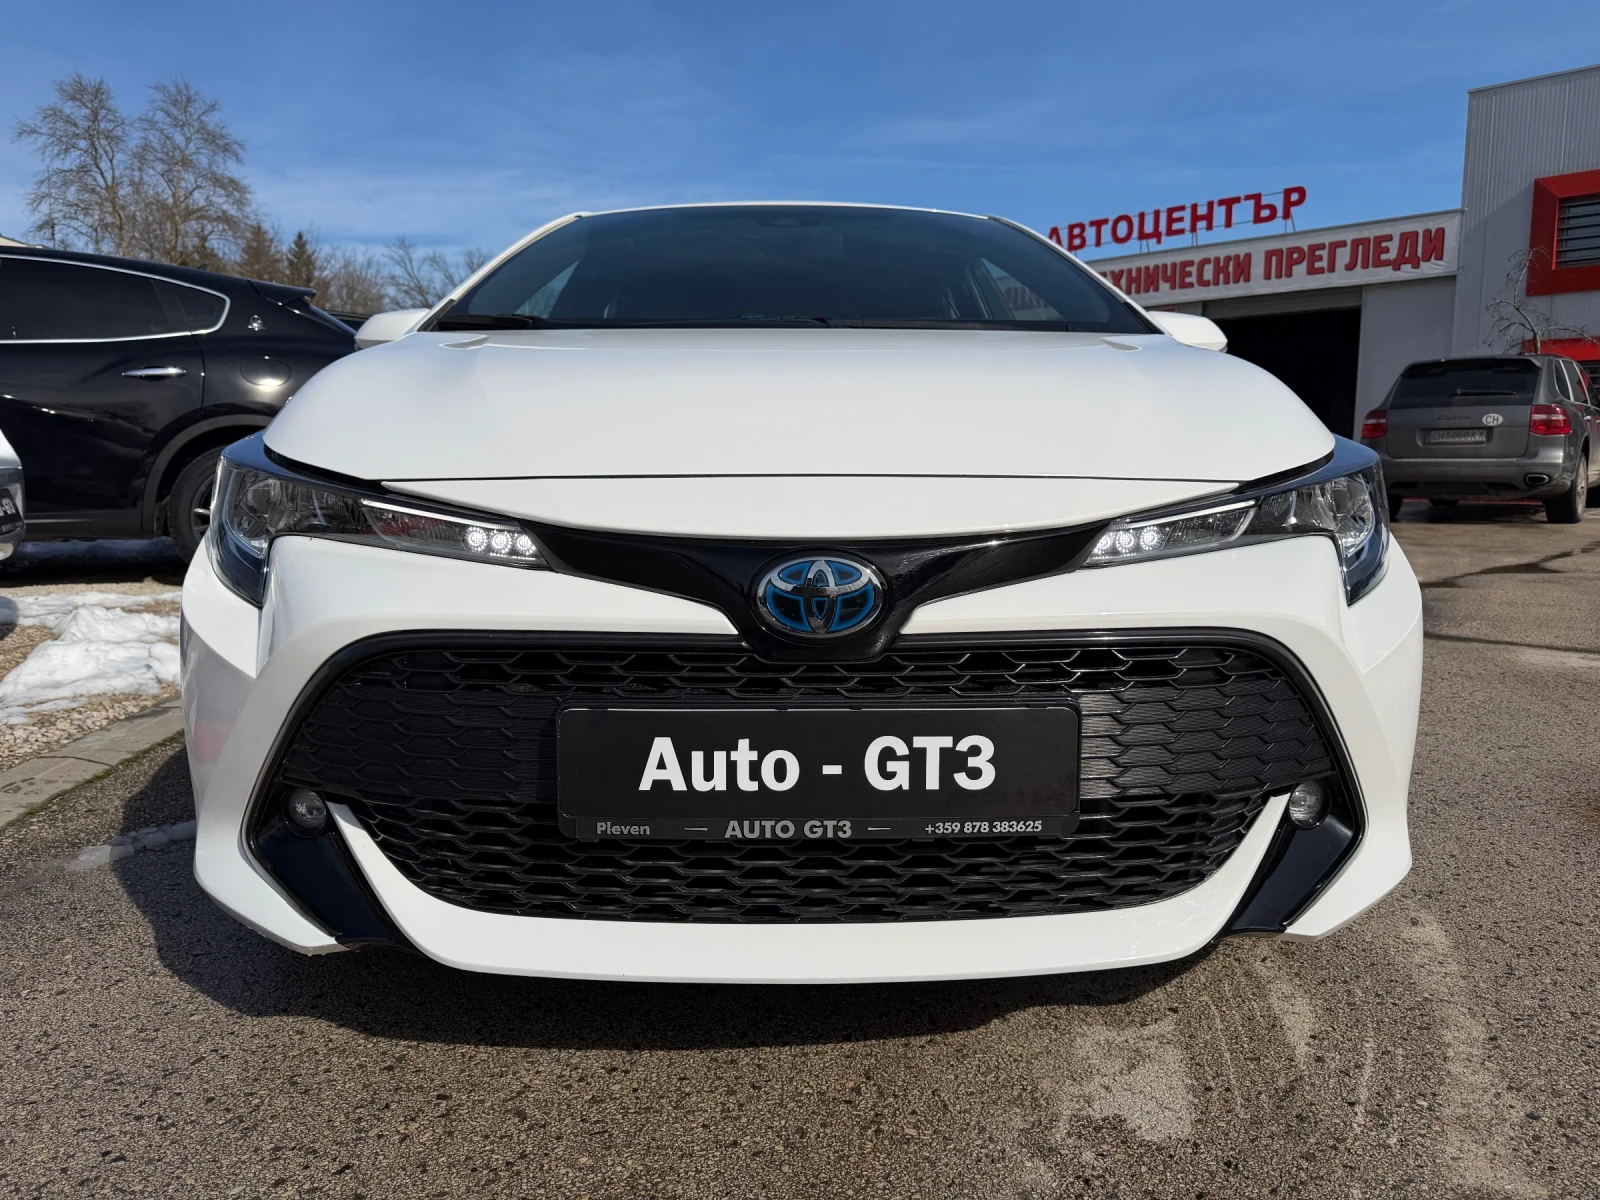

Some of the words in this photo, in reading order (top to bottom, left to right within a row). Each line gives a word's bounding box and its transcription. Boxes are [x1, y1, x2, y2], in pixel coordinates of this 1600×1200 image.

[1048, 186, 1306, 252] АВТОЦЕНТЪР
[1099, 252, 1251, 296] ХНИЧЕСКИ
[1264, 227, 1446, 281] ПРЕГЛЕДИ
[1485, 415, 1499, 425] CH
[638, 736, 800, 792] Auto
[822, 764, 843, 775] -
[864, 735, 996, 791] GT3
[597, 822, 650, 835] Pleven
[724, 820, 795, 839] AUTO
[803, 820, 852, 839] GT3
[925, 823, 960, 834] +359
[963, 822, 990, 833] 878
[992, 820, 1042, 833] 383625
